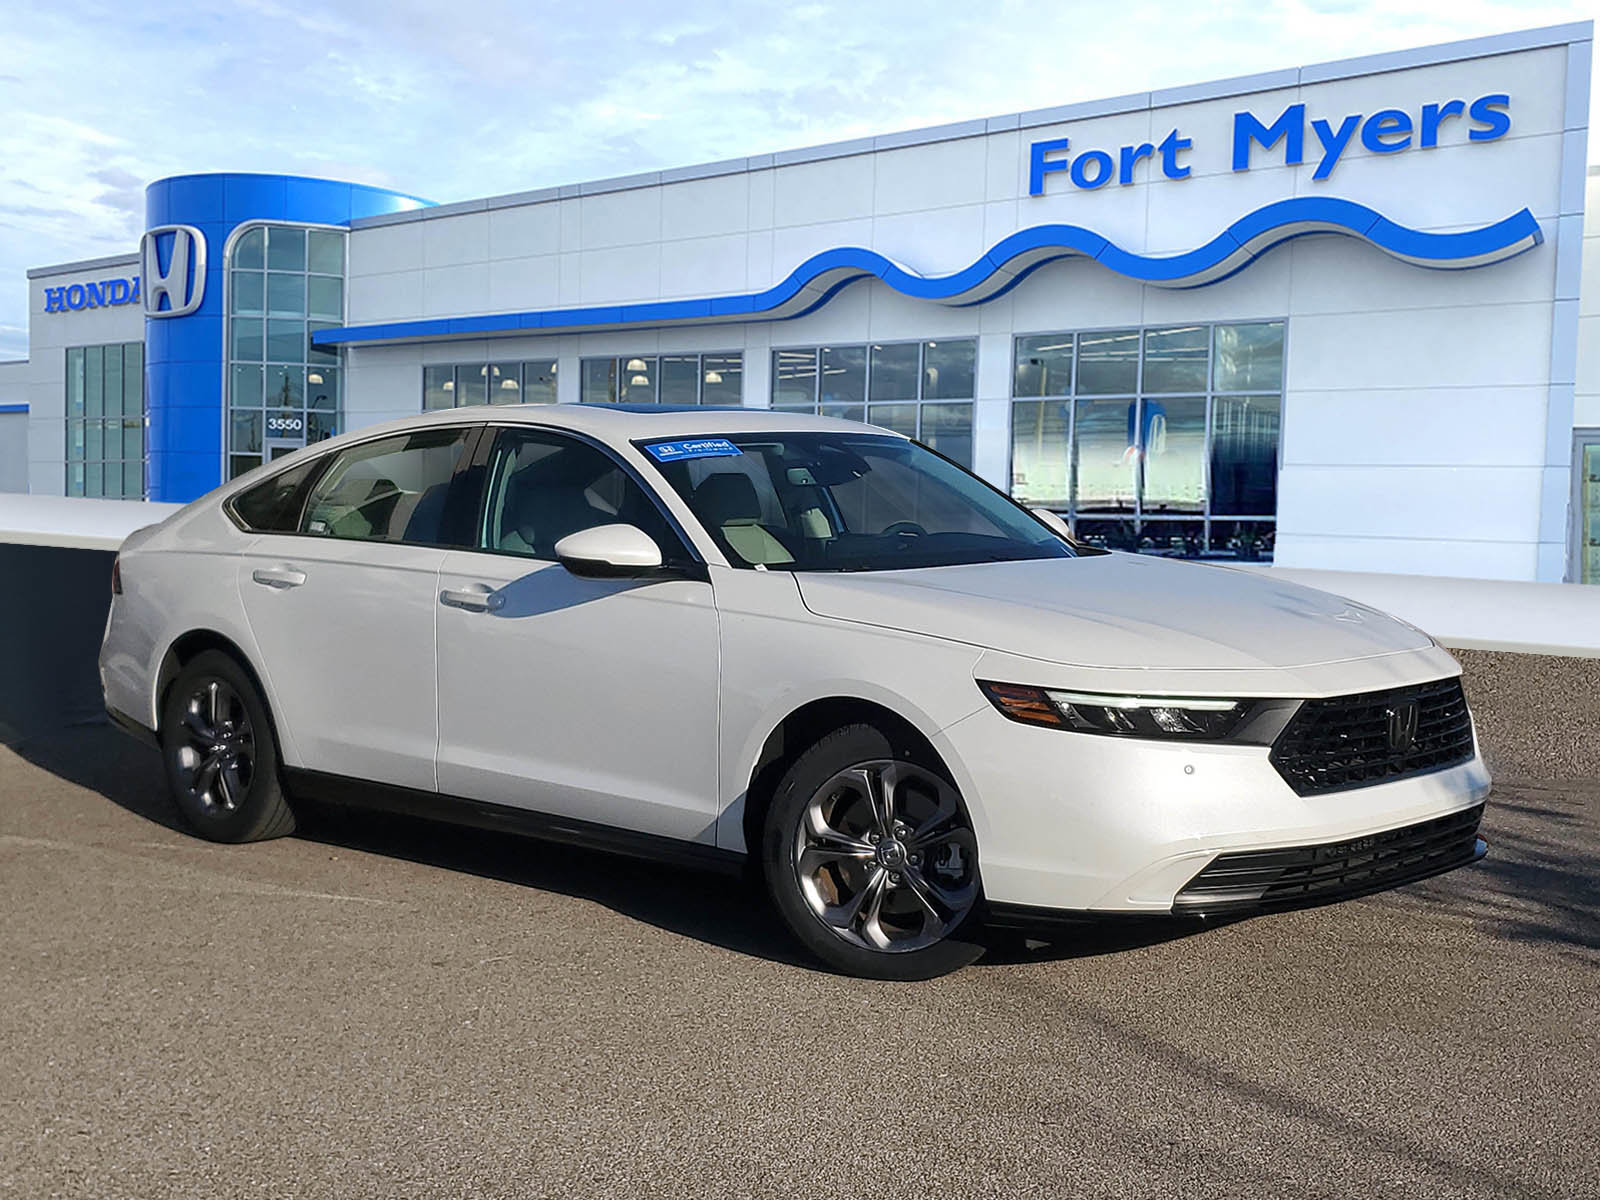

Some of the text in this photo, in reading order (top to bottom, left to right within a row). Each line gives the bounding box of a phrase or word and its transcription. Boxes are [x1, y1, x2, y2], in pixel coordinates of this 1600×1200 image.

[1029, 93, 1511, 196] Fort Myers
[267, 418, 302, 430] 3550
[682, 441, 729, 450] Certified
